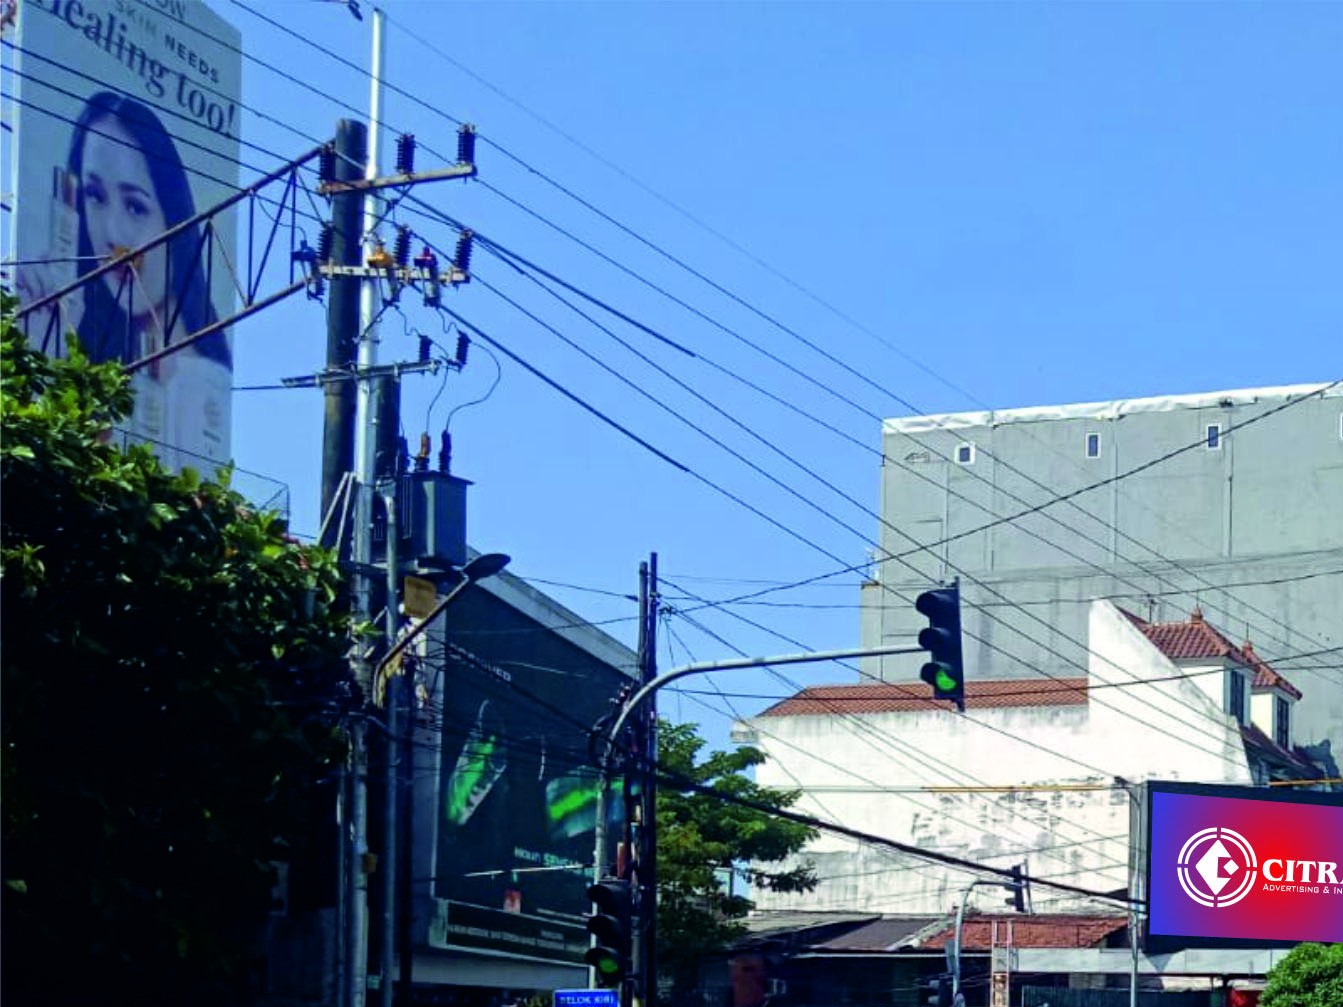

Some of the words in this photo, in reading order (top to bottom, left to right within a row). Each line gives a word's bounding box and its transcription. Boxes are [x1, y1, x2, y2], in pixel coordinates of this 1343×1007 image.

[165, 34, 219, 83] NEEDS
[177, 73, 236, 138] too!
[1262, 883, 1319, 894] ADVERTISING
[1322, 885, 1330, 894] &
